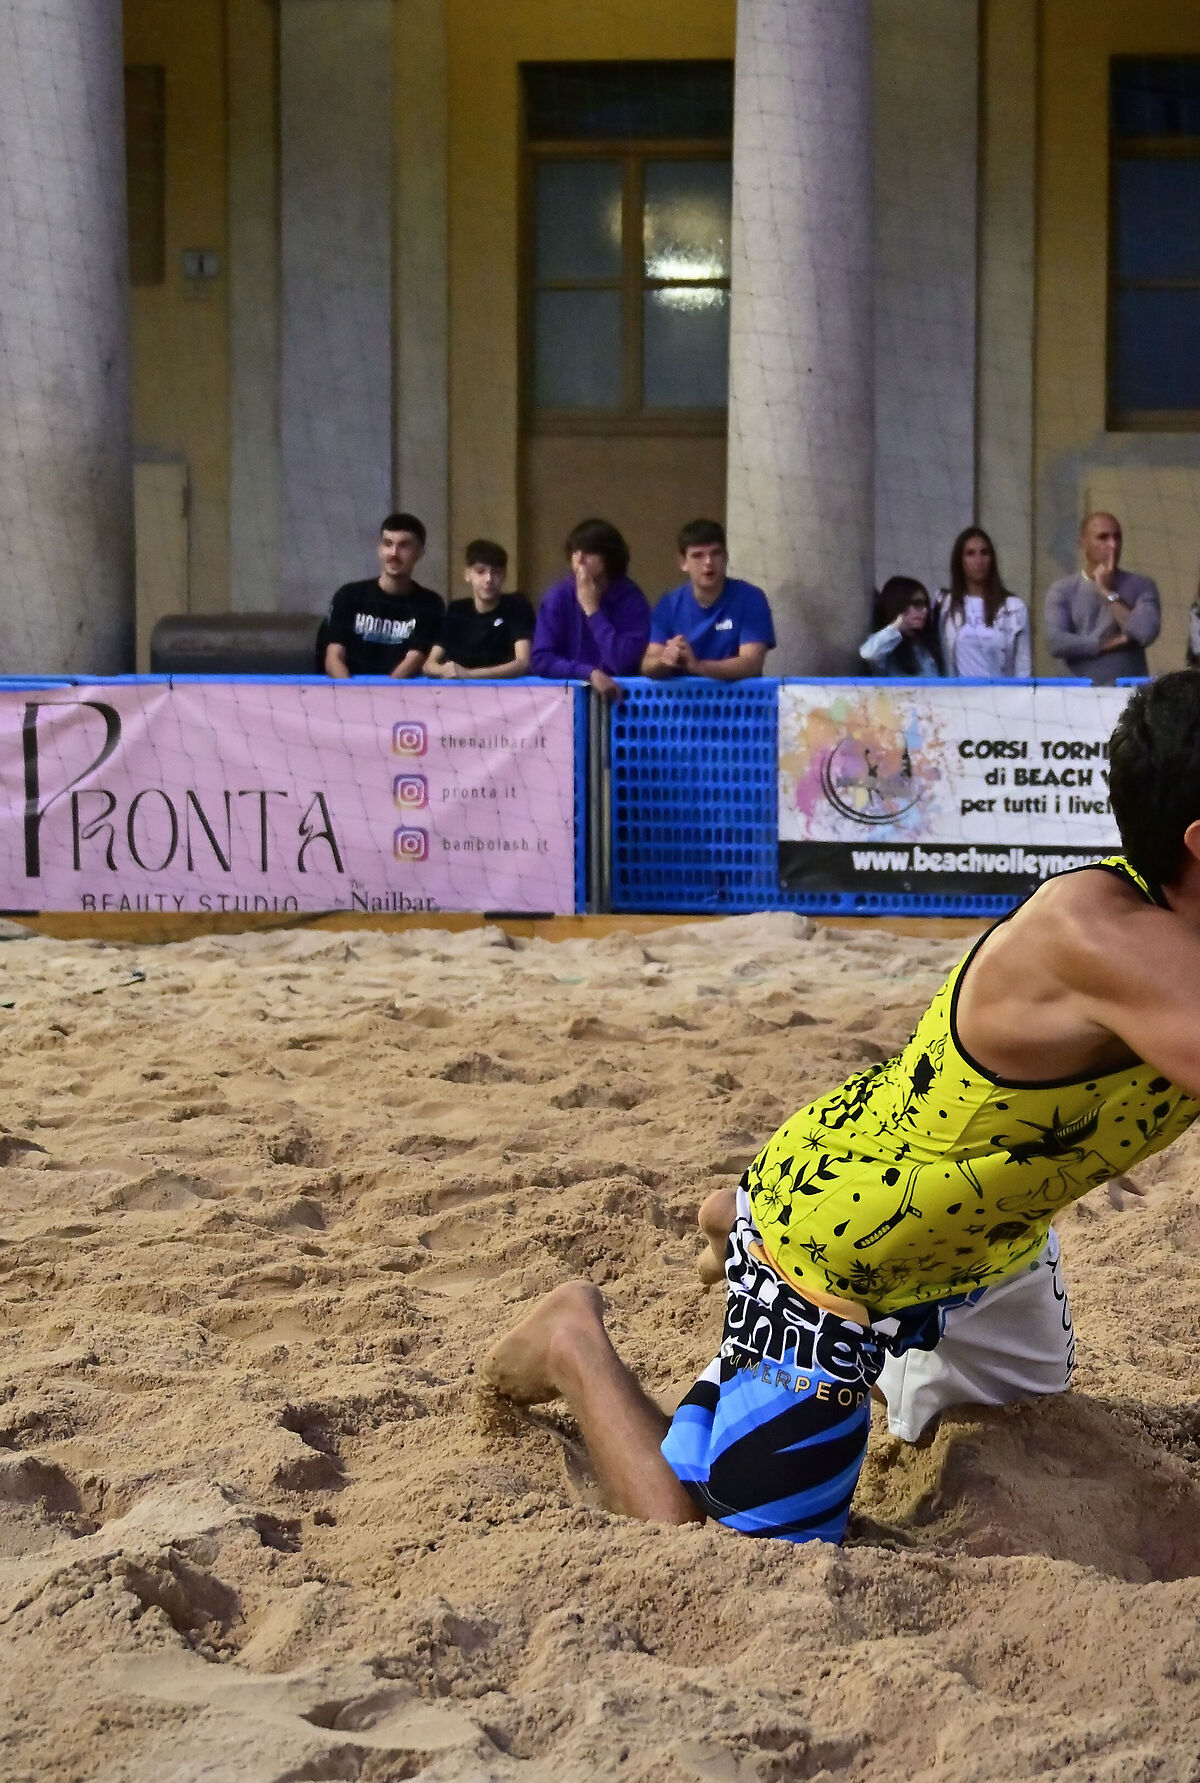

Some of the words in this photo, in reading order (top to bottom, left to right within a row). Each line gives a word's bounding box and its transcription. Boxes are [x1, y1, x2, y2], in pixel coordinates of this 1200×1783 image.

[985, 768, 1005, 785] di
[1014, 768, 1093, 786] BEACH
[23, 702, 345, 878] PRONTA
[961, 798, 996, 815] per
[1004, 795, 1047, 813] tutti
[1055, 795, 1061, 813] i
